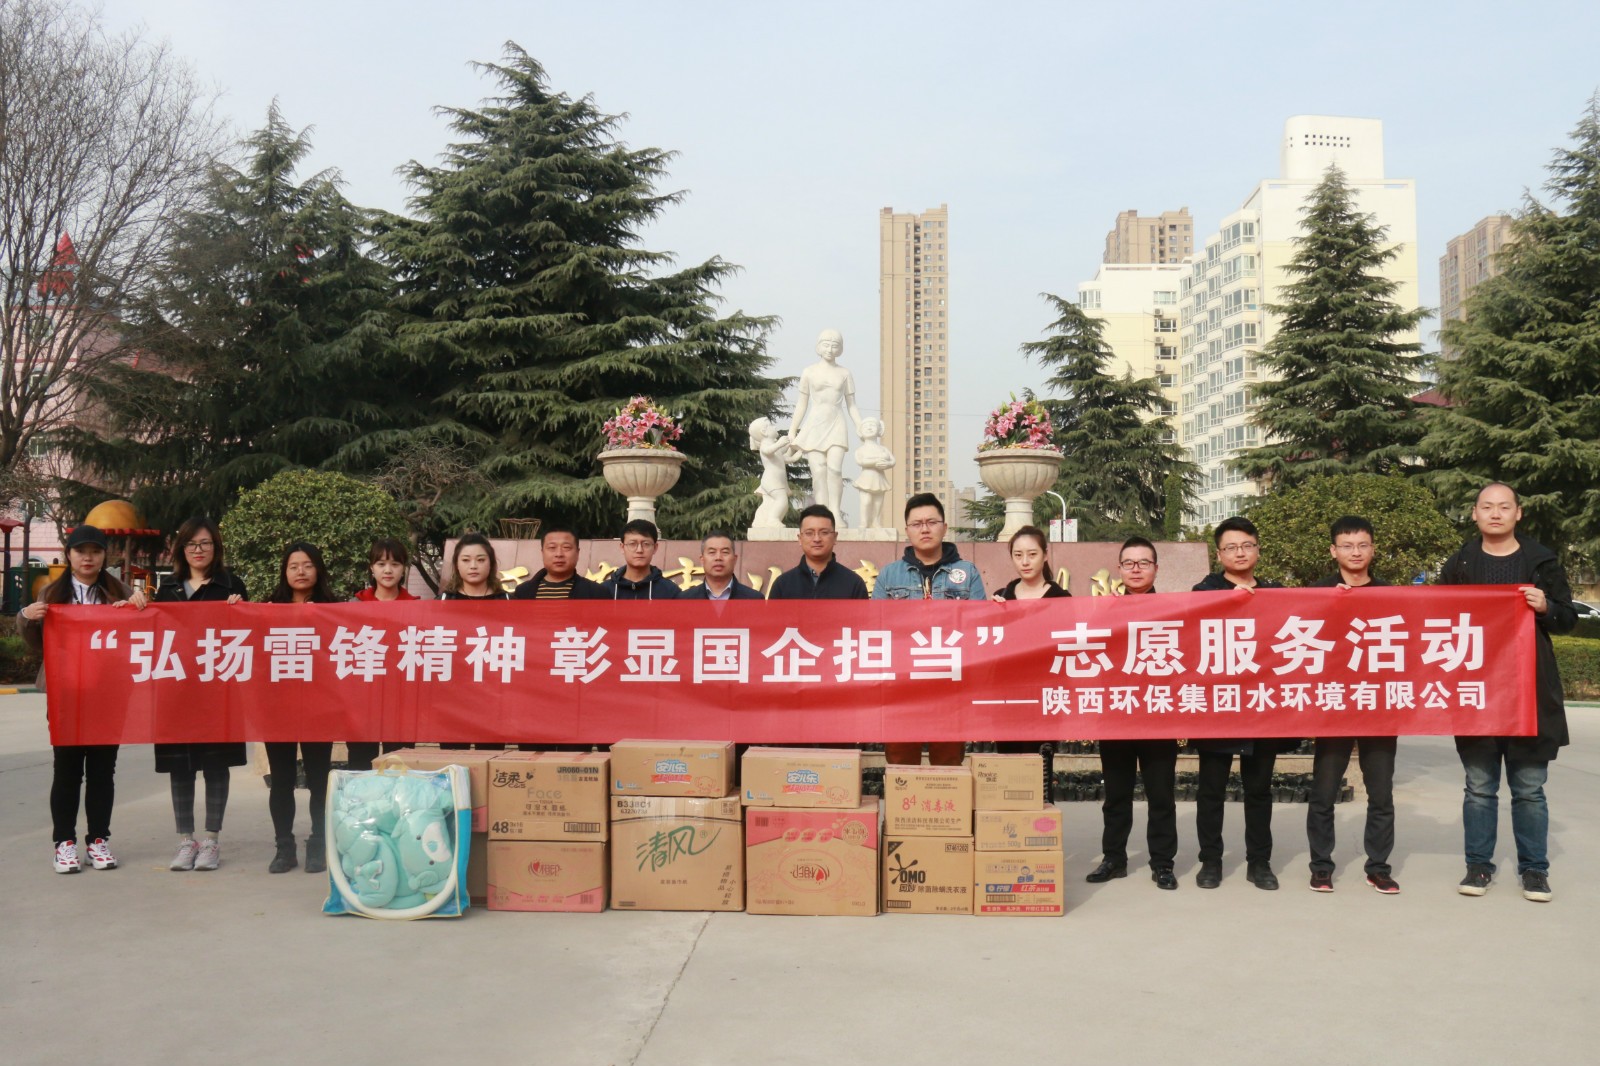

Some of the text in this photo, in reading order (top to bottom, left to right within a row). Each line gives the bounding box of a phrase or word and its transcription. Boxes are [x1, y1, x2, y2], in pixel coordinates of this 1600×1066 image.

[1049, 613, 1484, 677] 志愿服务活动
[656, 761, 687, 774] 安儿乐
[492, 769, 522, 787] 洁柔
[787, 771, 818, 784] 安儿乐
[616, 780, 624, 789] L
[527, 788, 562, 799] Face
[747, 790, 754, 800] L
[492, 821, 509, 834] 48
[636, 825, 721, 873] 清风
[899, 870, 926, 884] OMO
